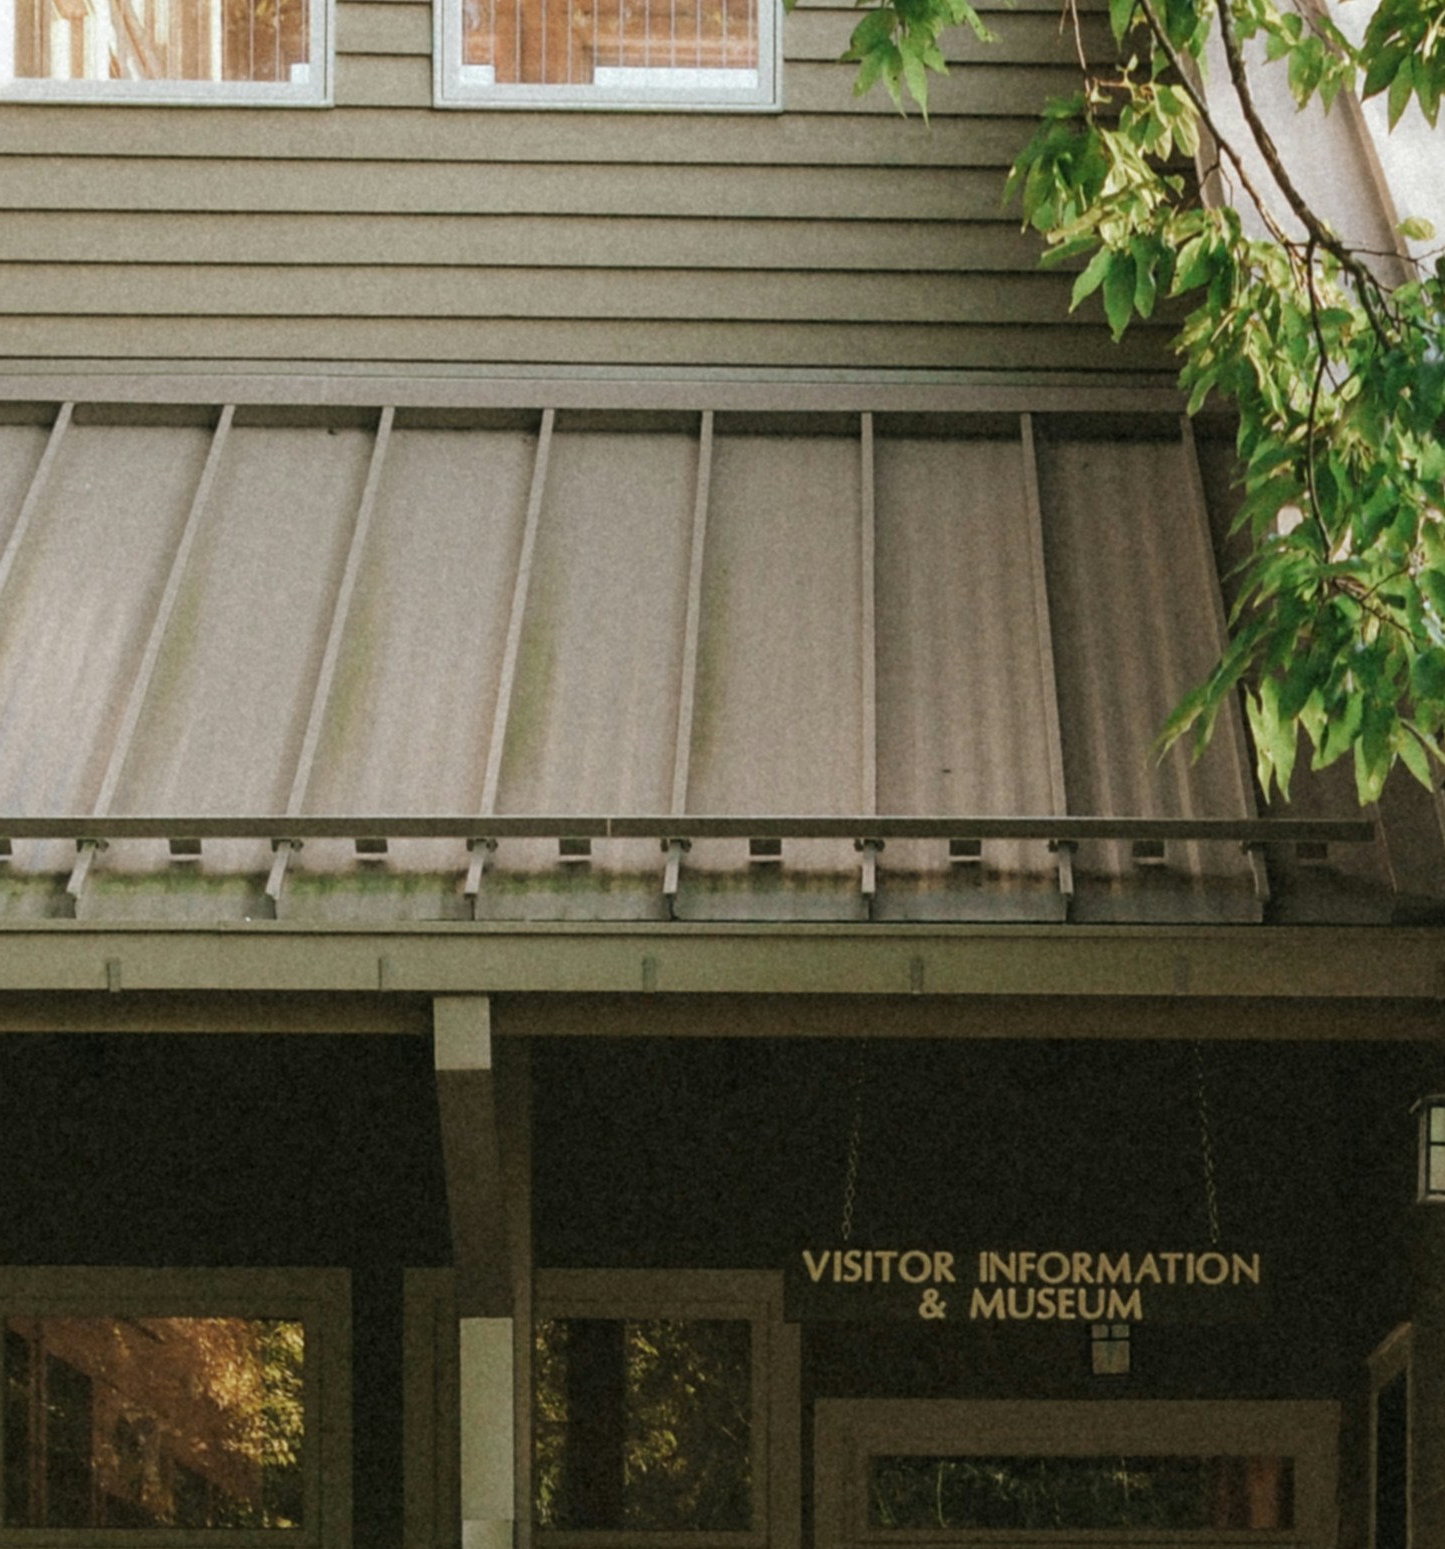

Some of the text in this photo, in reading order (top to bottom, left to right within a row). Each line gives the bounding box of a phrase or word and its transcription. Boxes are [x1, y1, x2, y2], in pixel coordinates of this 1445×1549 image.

[803, 1250, 1260, 1285] VISITOR INFORMATION
[918, 1288, 1143, 1320] & MUSEUM
